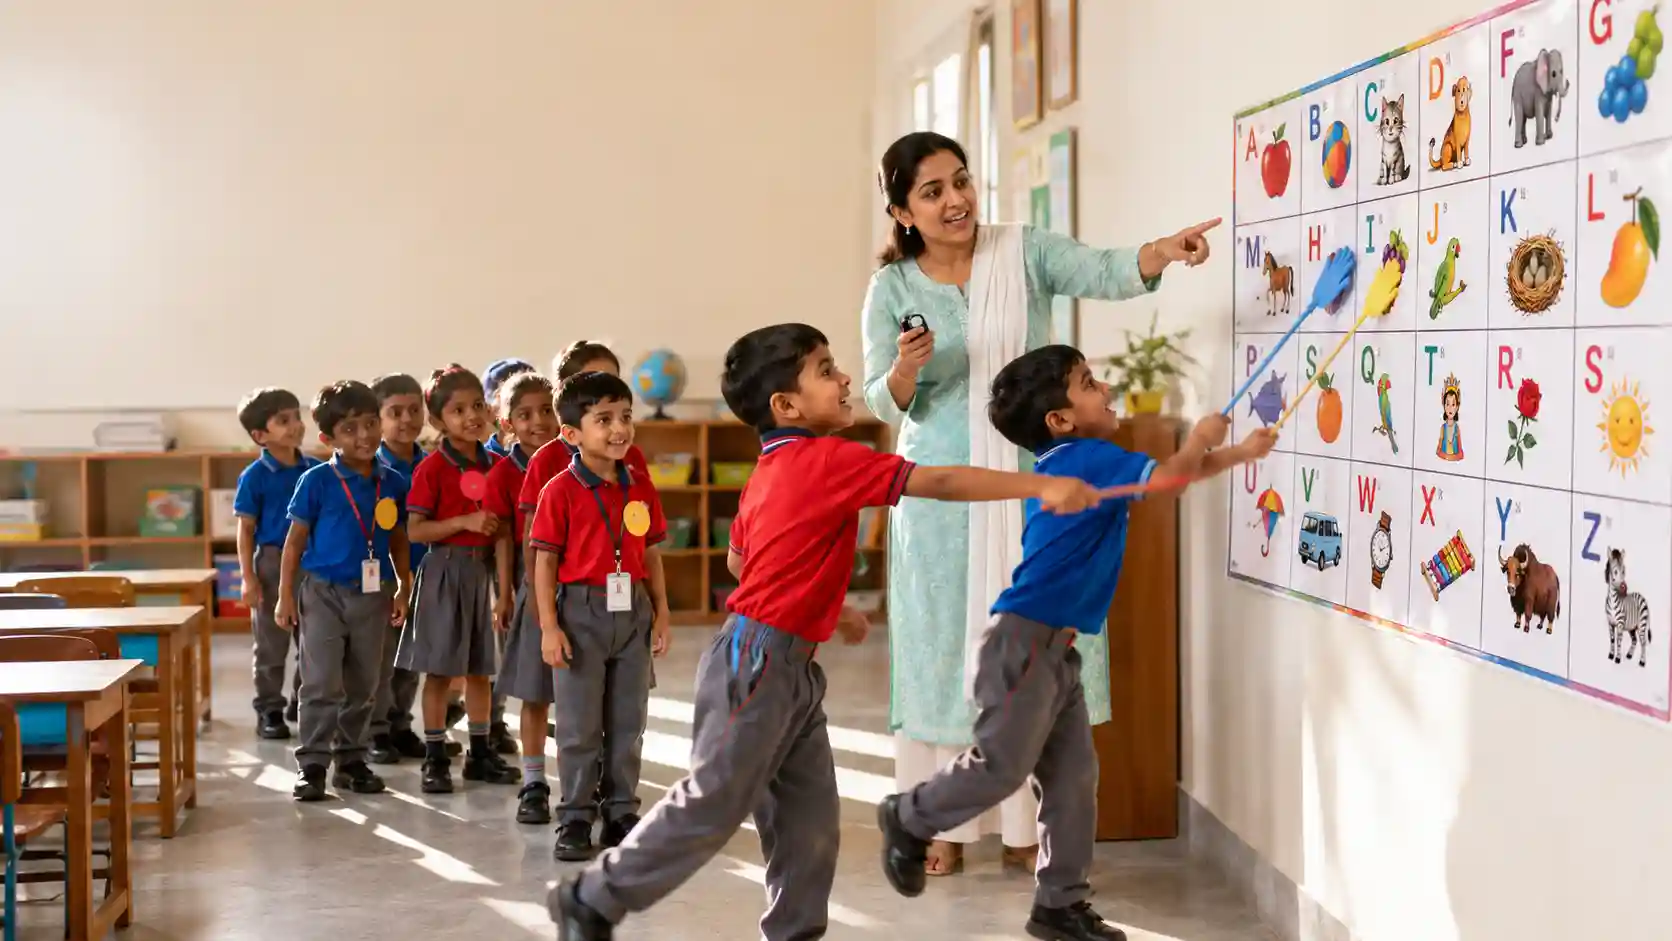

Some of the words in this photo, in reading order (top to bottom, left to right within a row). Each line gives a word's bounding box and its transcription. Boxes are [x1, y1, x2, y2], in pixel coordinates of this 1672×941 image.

[1589, 0, 1612, 44] G
[1500, 28, 1515, 78] F
[1429, 58, 1444, 100] D
[1364, 82, 1378, 122] C
[1310, 104, 1320, 141] B
[1245, 127, 1258, 162] A
[1501, 188, 1517, 234] K
[1588, 173, 1605, 221] L
[1309, 225, 1321, 262] H
[1366, 215, 1375, 253] I
[1427, 203, 1439, 244] J
[1246, 235, 1260, 268] M
[1246, 345, 1257, 378] P
[1306, 344, 1318, 380] S
[1361, 346, 1374, 385] Q
[1424, 346, 1438, 386] T
[1498, 346, 1514, 390] R
[1584, 345, 1604, 394] S
[1245, 462, 1257, 494] U
[1302, 467, 1314, 502] V
[1358, 475, 1376, 514] W
[1420, 484, 1436, 527] X
[1496, 496, 1512, 541] Y
[1581, 512, 1602, 562] Z
